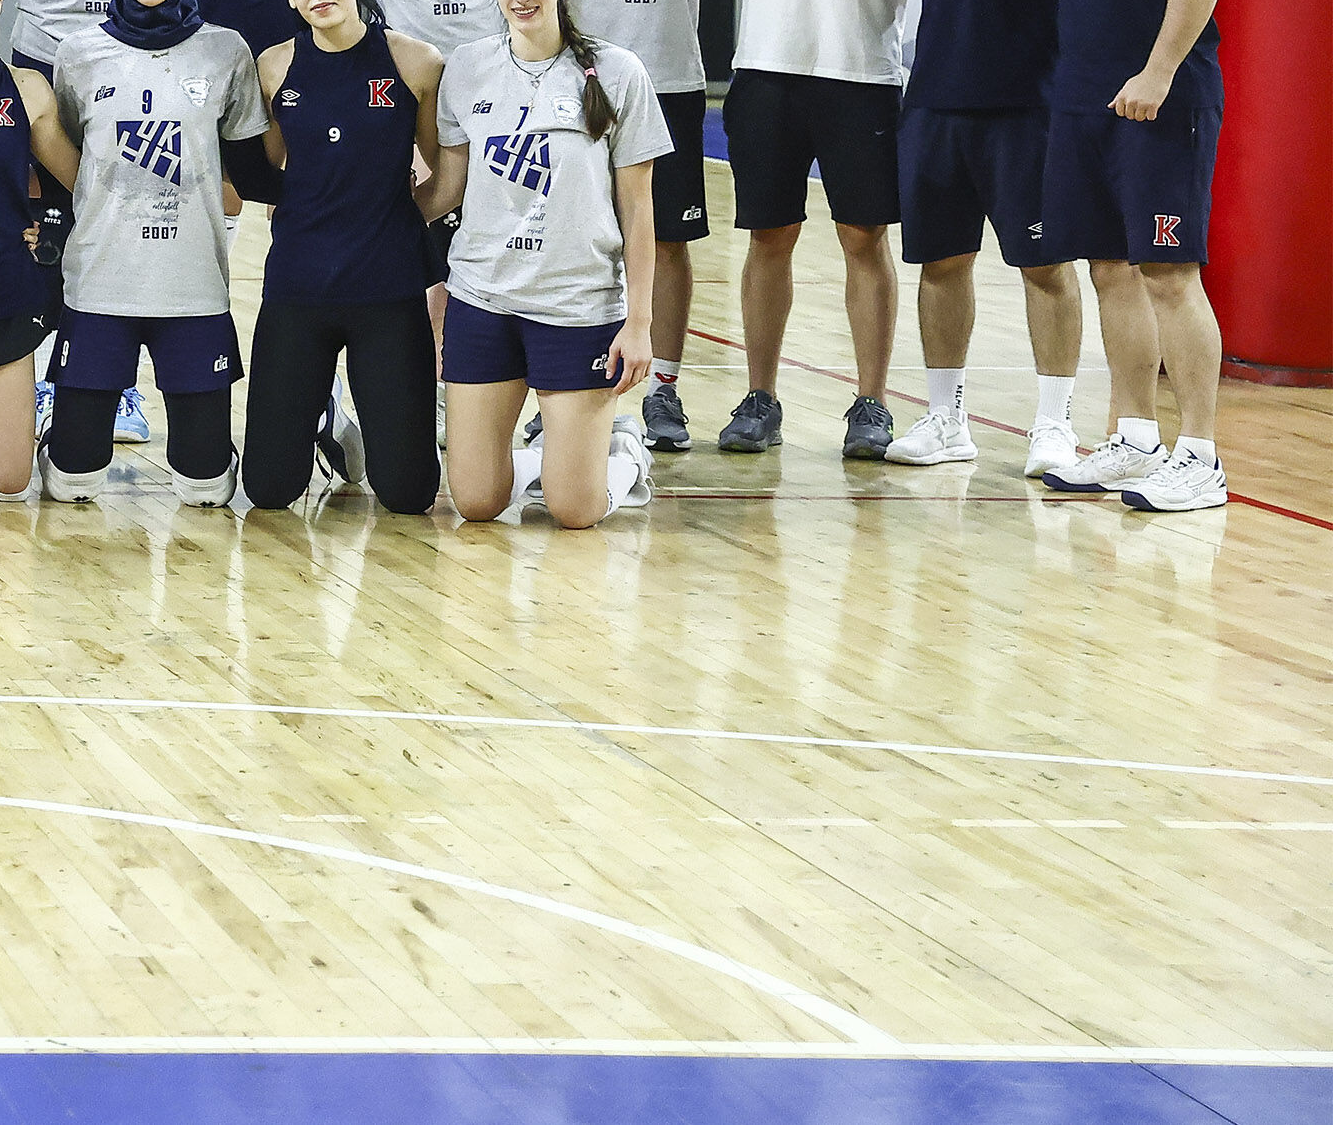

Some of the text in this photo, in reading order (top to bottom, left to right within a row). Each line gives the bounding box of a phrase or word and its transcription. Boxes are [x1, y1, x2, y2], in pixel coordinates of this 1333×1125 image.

[85, 1, 110, 12] 200
[434, 3, 467, 15] 2007
[369, 78, 395, 108] K
[141, 89, 153, 114] 9
[328, 127, 341, 142] 9
[44, 216, 61, 225] errea
[142, 226, 178, 239] 2007
[1153, 214, 1182, 248] K
[506, 236, 544, 251] 2007
[60, 340, 70, 367] 9
